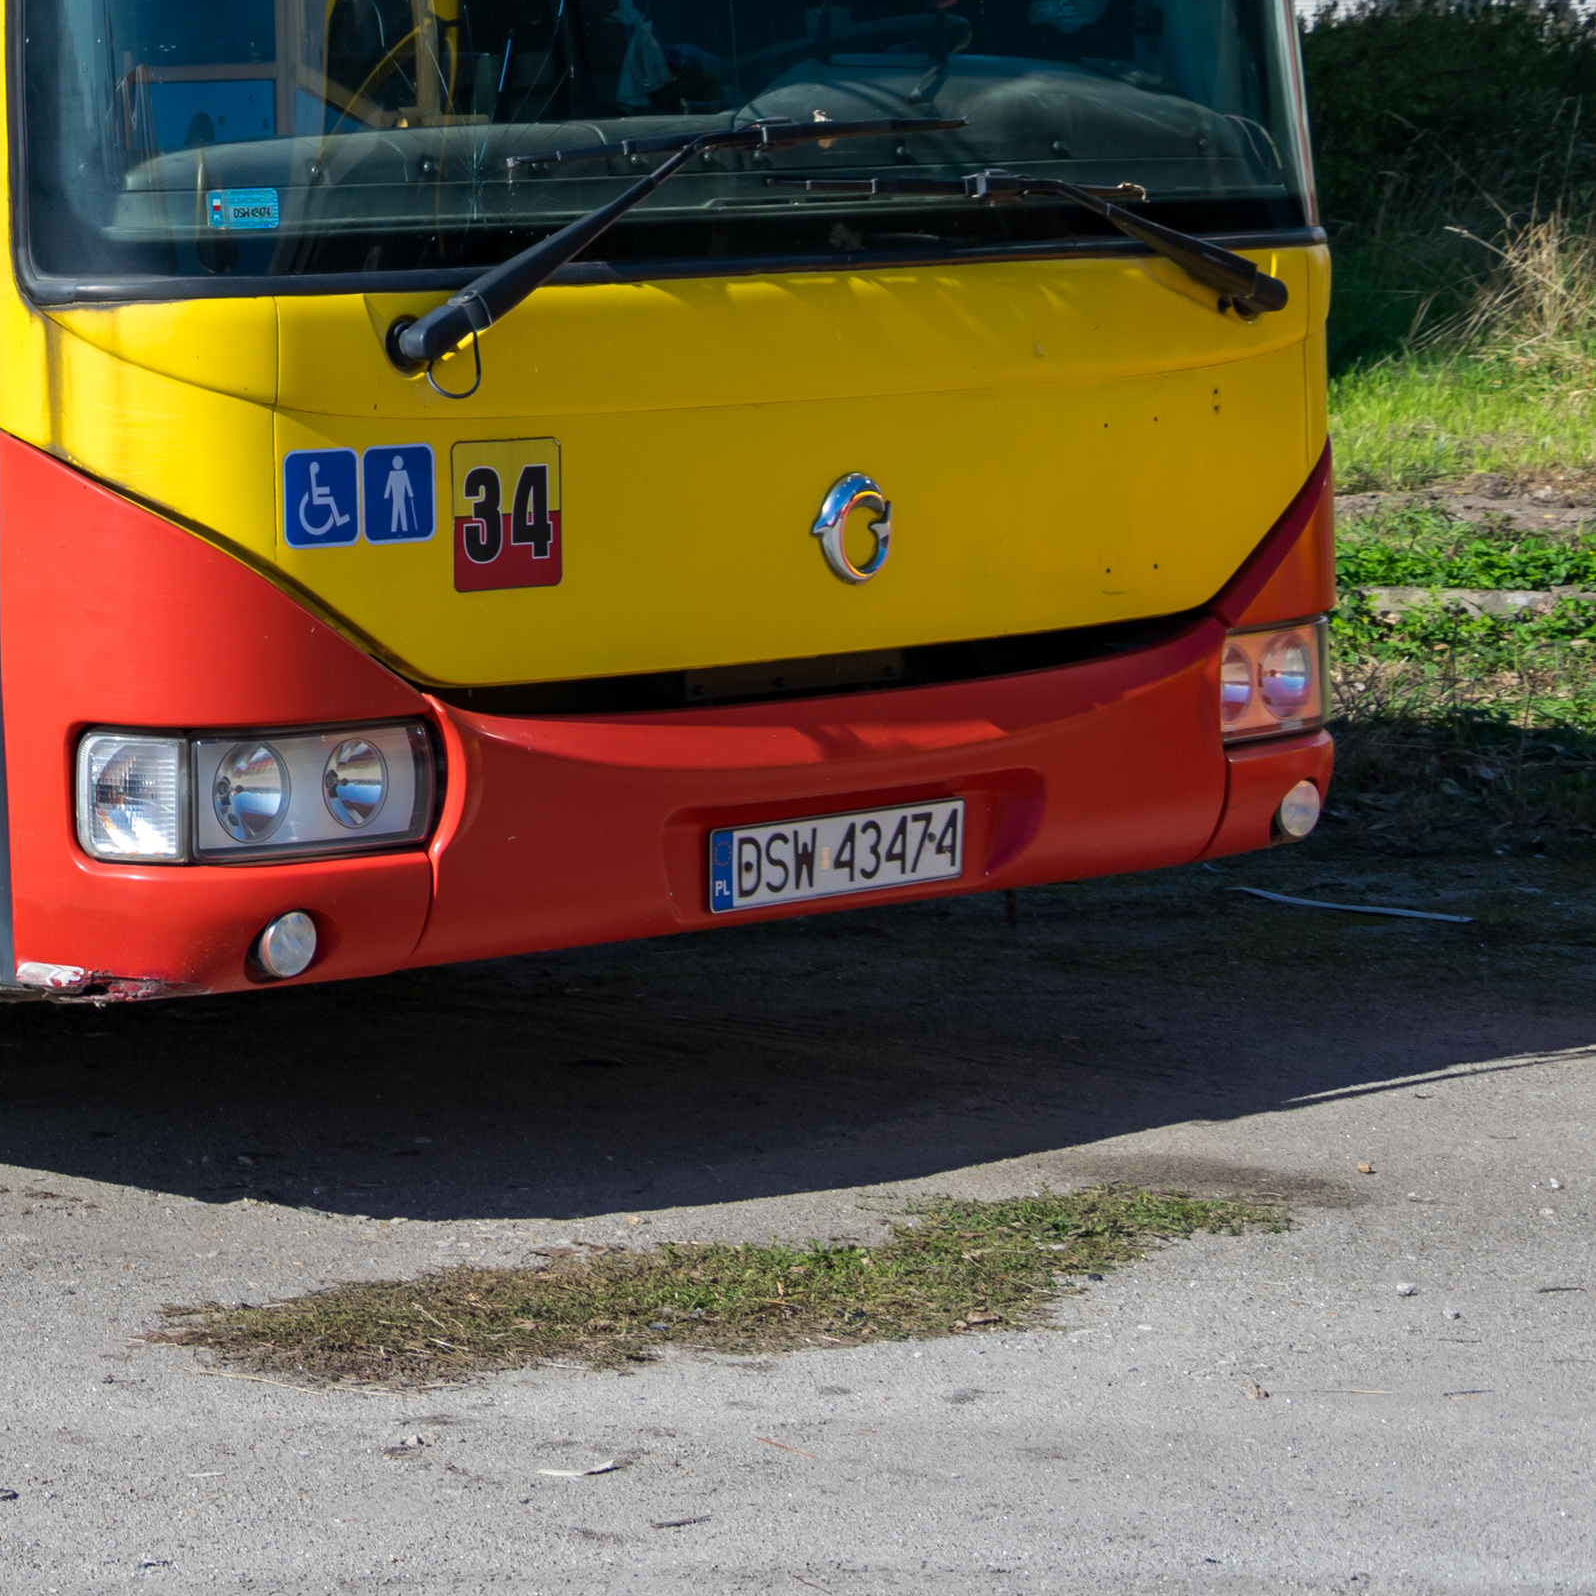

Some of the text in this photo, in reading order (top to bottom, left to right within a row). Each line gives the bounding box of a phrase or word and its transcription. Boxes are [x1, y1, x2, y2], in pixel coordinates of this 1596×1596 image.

[463, 463, 553, 564] 34
[715, 880, 730, 896] PL
[738, 808, 959, 898] DSW 43474
